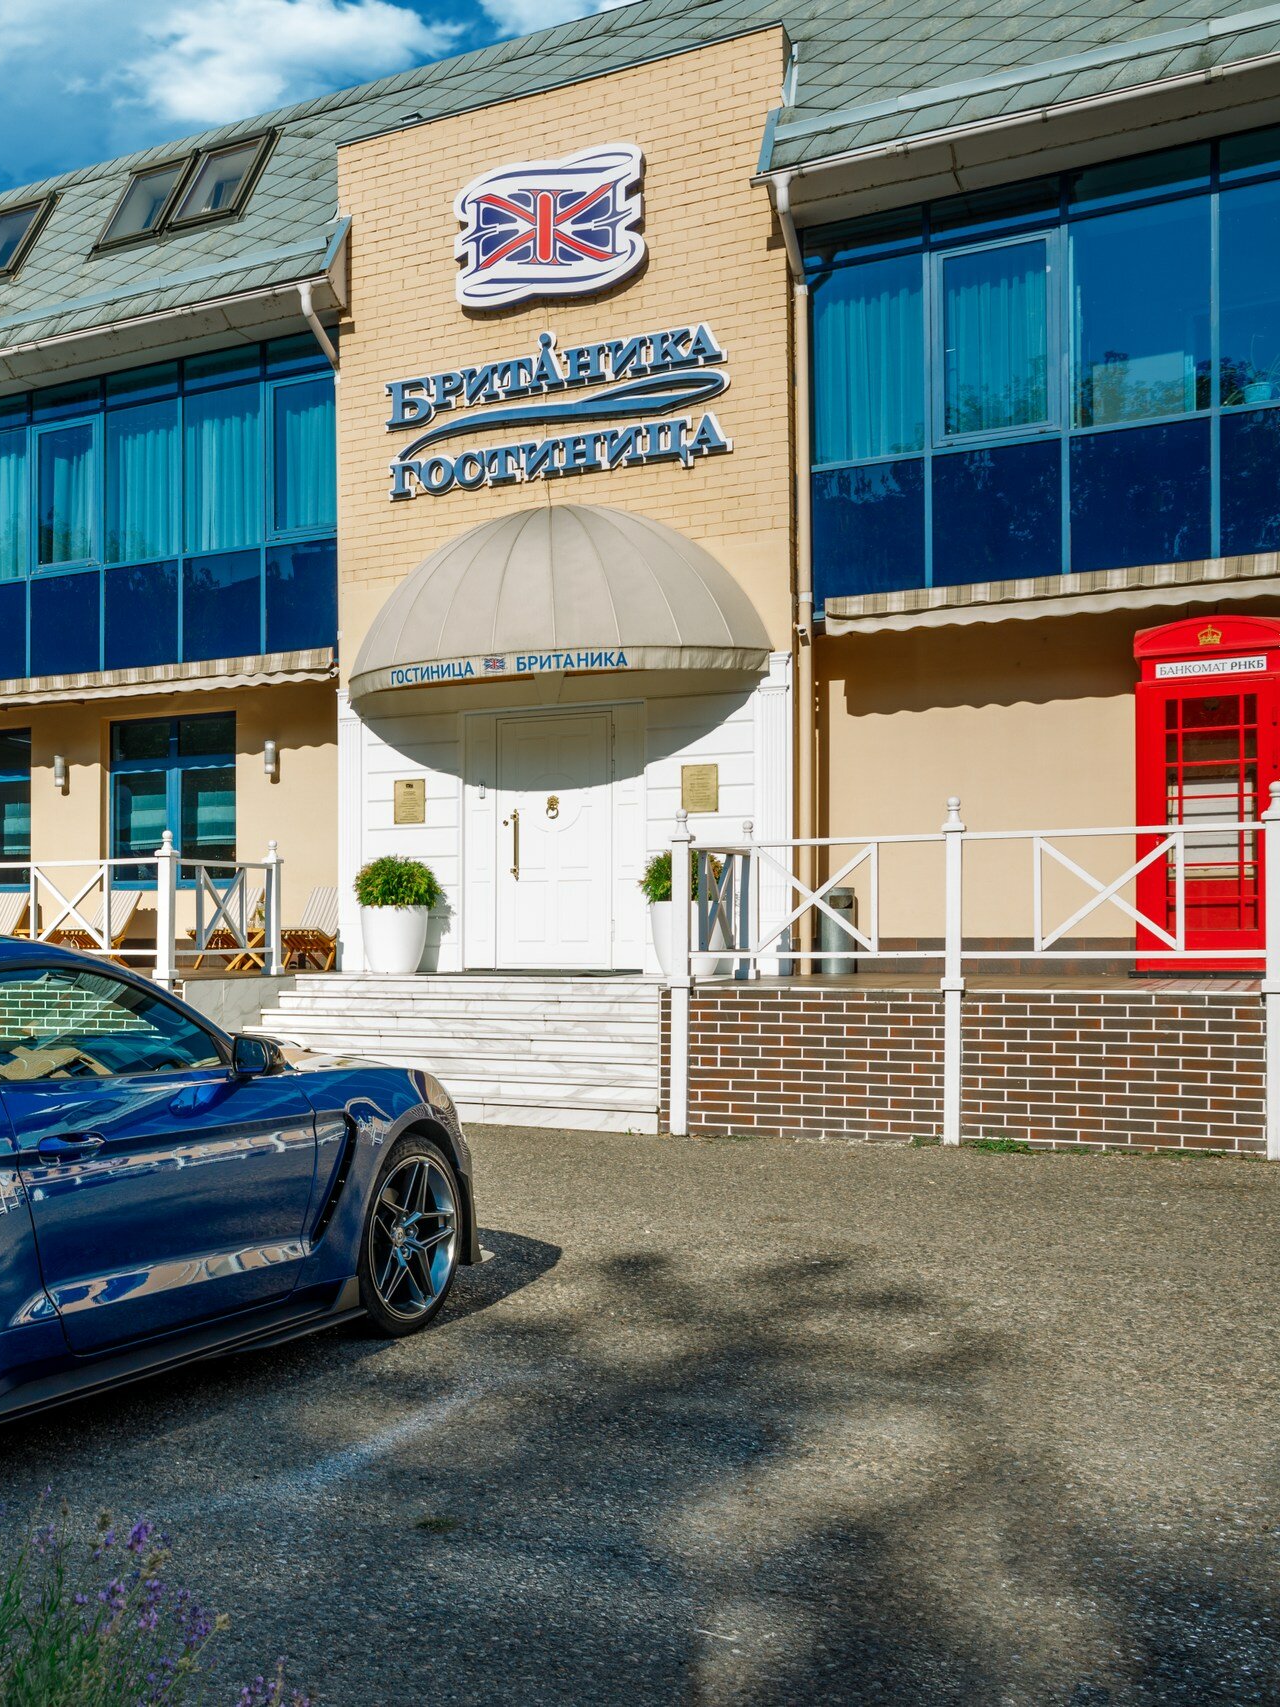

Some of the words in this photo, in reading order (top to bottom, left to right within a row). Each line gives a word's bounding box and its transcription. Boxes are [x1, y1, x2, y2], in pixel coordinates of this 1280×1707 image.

[389, 412, 734, 501] ГОСТИНИЦА
[391, 661, 474, 685] ГОСТИНИЦА
[516, 651, 628, 672] БРИТАНИКА
[1159, 661, 1228, 676] БАНКОМАТ
[1230, 659, 1264, 670] РНКБ
